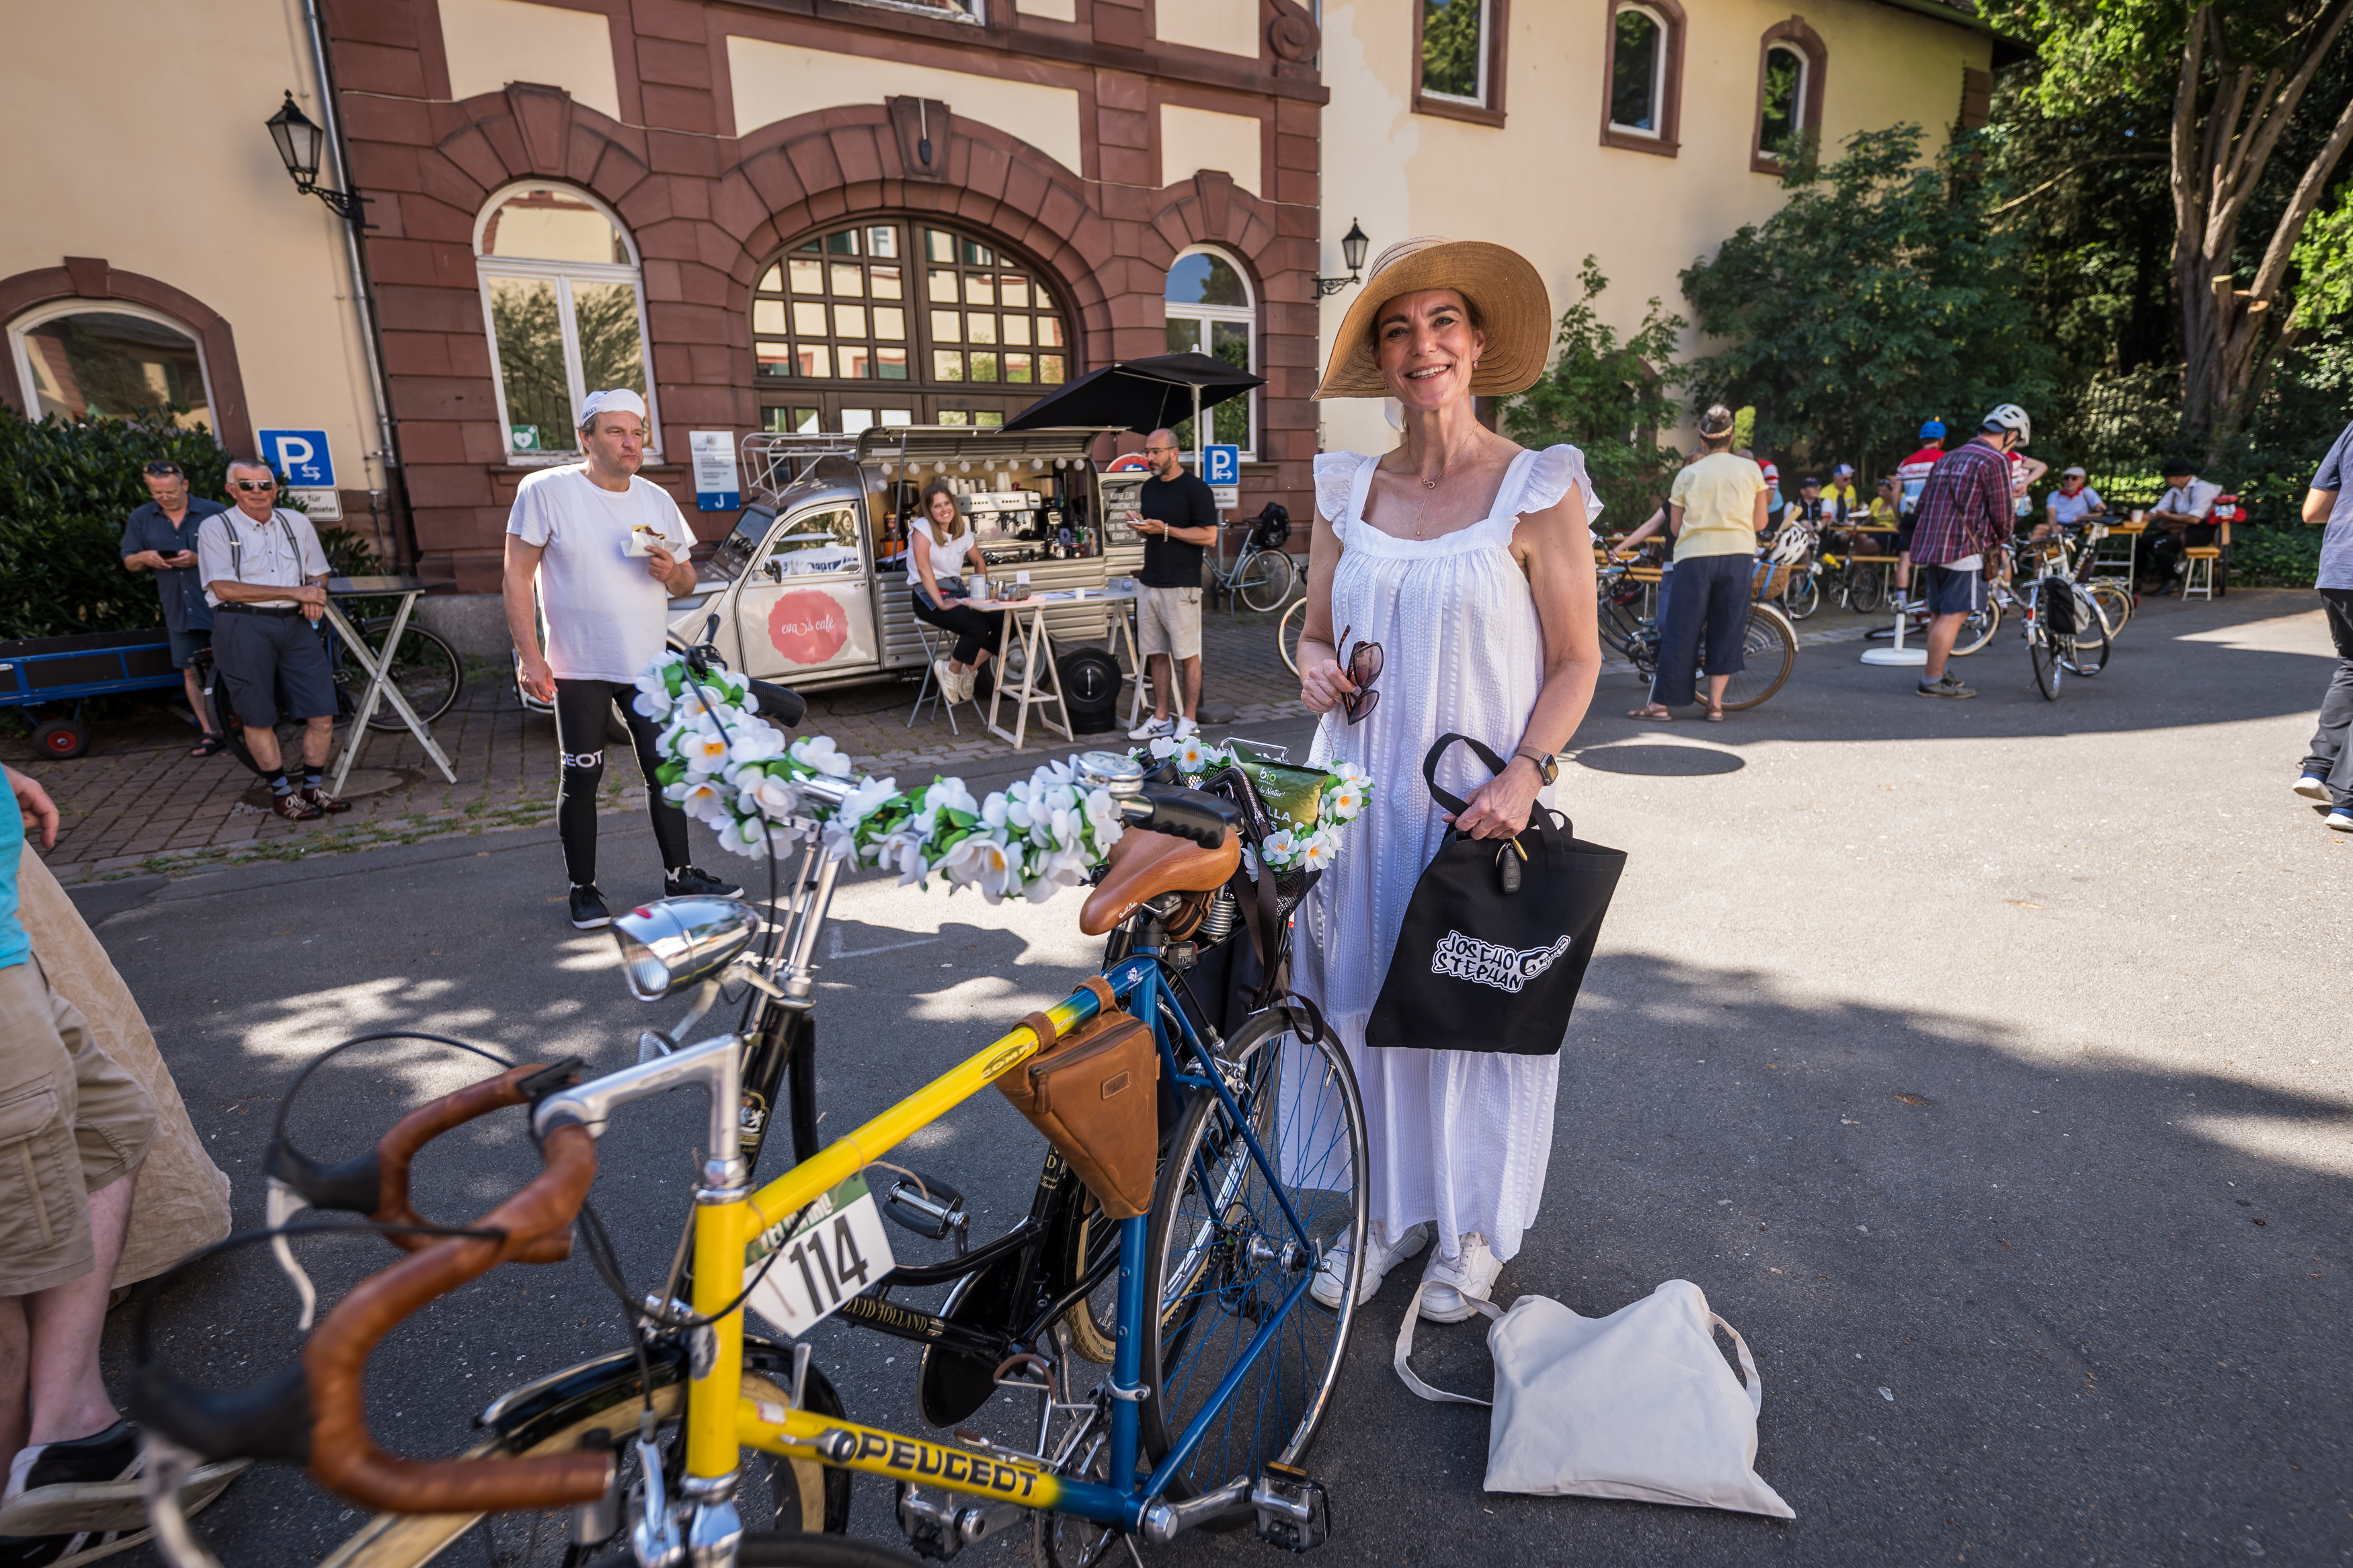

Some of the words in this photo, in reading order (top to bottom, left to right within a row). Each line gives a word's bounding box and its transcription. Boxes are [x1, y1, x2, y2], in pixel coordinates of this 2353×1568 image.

[276, 436, 314, 479] P
[1212, 450, 1230, 480] P
[715, 494, 724, 508] J
[815, 614, 835, 632] café
[1259, 767, 1277, 782] bio
[1265, 787, 1285, 798] Natur!
[1442, 935, 1513, 971] JOSCHO
[1434, 952, 1523, 989] STEPHAN
[789, 1214, 869, 1316] 114
[854, 1432, 1038, 1497] PEUGEOT
